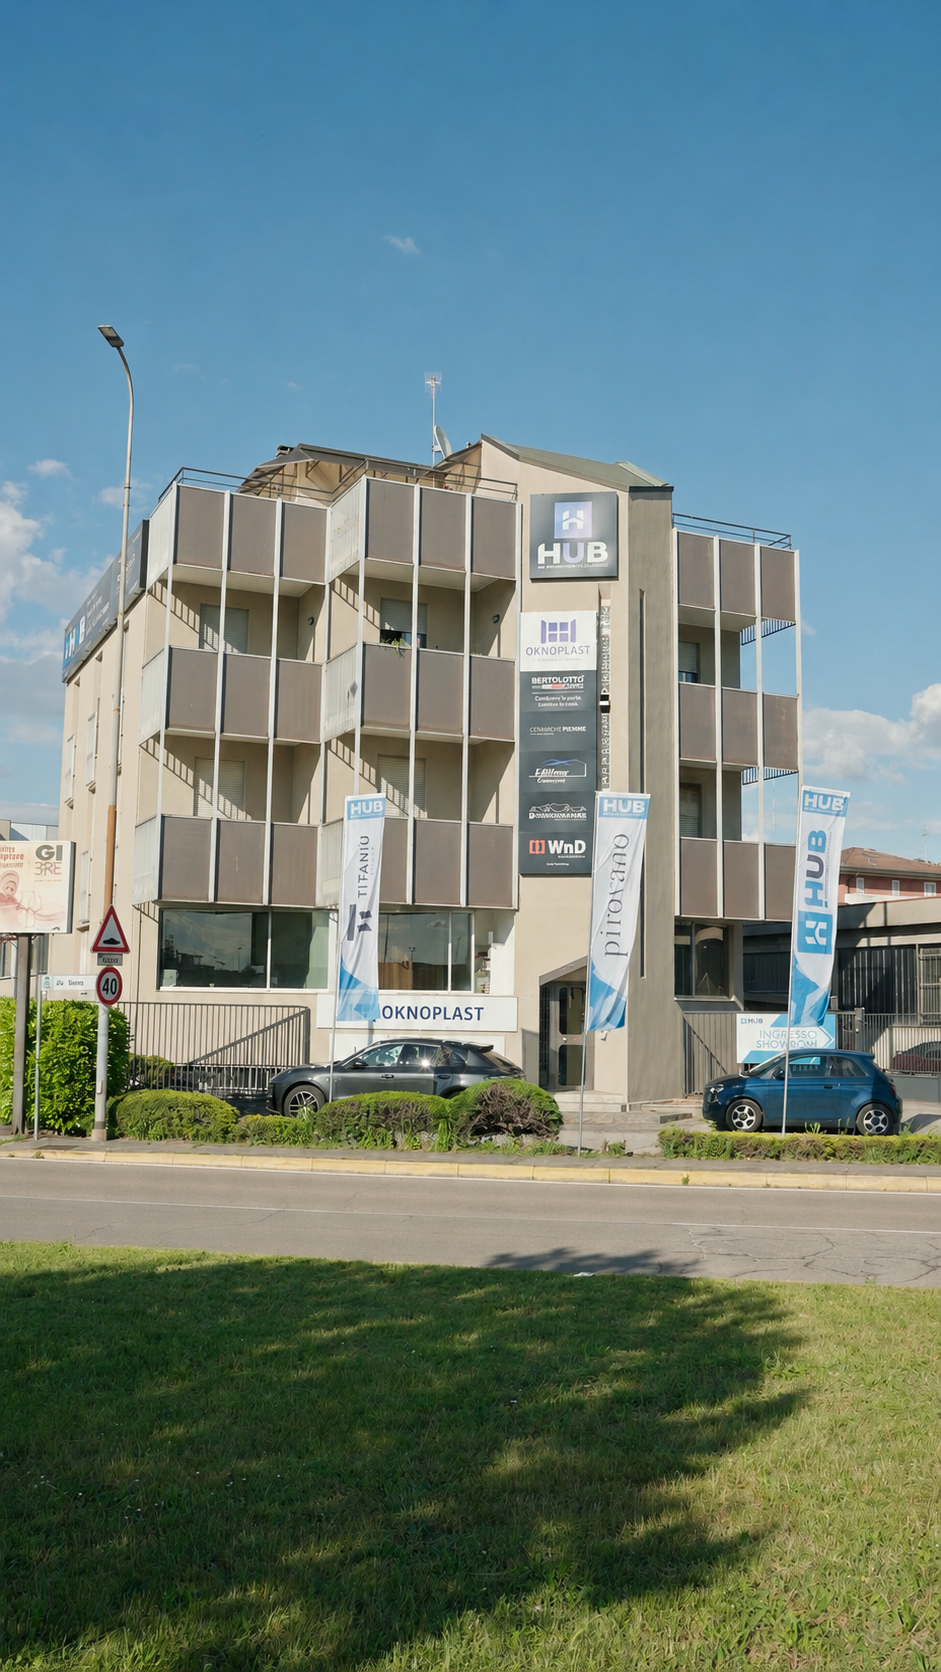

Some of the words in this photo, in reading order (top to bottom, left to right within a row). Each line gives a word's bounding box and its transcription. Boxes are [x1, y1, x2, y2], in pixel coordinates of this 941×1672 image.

[537, 541, 609, 565] HUB
[525, 645, 591, 656] OKNOPLAST
[531, 675, 585, 685] BERTOLOTTO
[350, 800, 383, 816] HUB
[602, 799, 646, 813] HUB
[804, 793, 844, 812] HUB
[35, 844, 63, 861] GI
[547, 839, 587, 855] WnD
[804, 830, 827, 907] HUB
[600, 833, 631, 957] pirovano
[102, 977, 118, 995] 40
[381, 1004, 484, 1021] OKNOPLAST
[747, 1017, 764, 1025] HUB
[759, 1029, 818, 1040] INGRESSO
